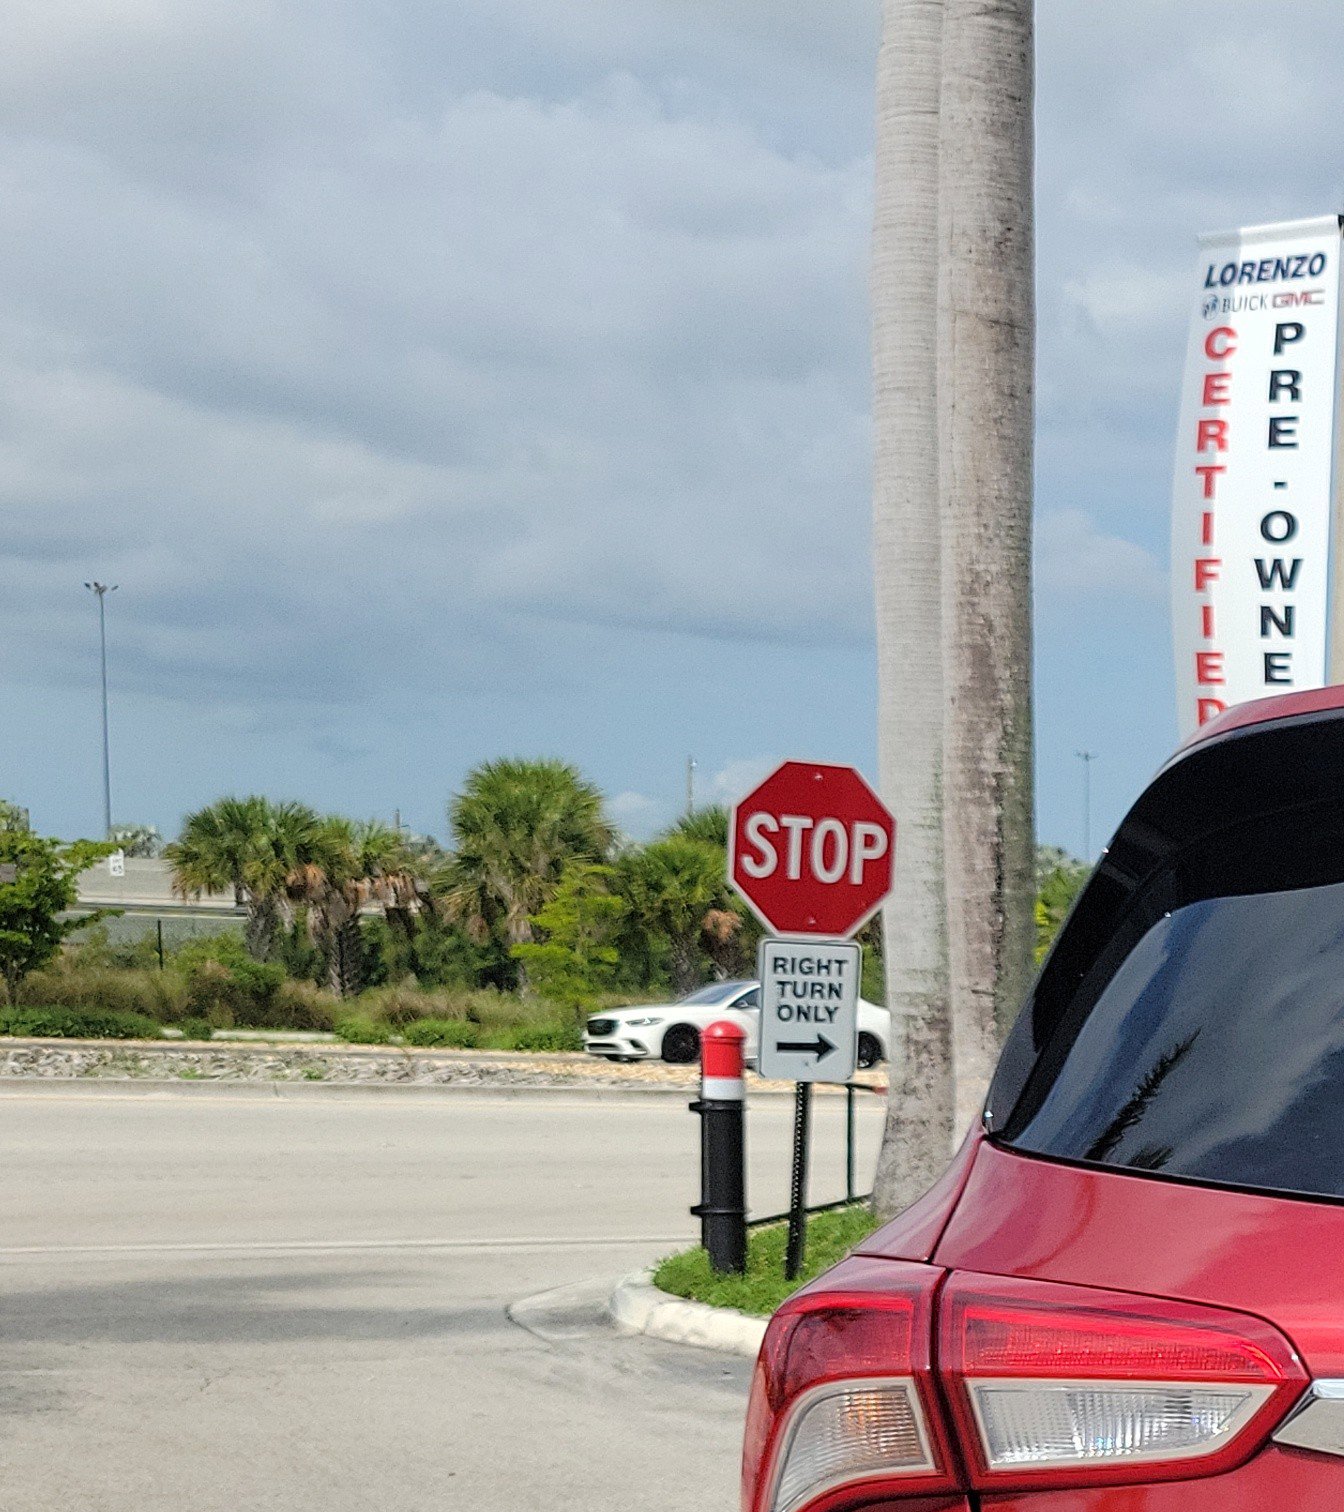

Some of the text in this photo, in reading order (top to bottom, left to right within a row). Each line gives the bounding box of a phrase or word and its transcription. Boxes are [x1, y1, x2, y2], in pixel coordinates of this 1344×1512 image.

[1204, 252, 1327, 288] LORENZO
[1222, 288, 1326, 313] BUICK GMC
[1254, 321, 1306, 686] PRE-OWNE
[740, 811, 888, 886] STOP
[773, 957, 848, 977] RIGHT
[776, 980, 843, 1000] TURN
[776, 1003, 840, 1024] ONLY
